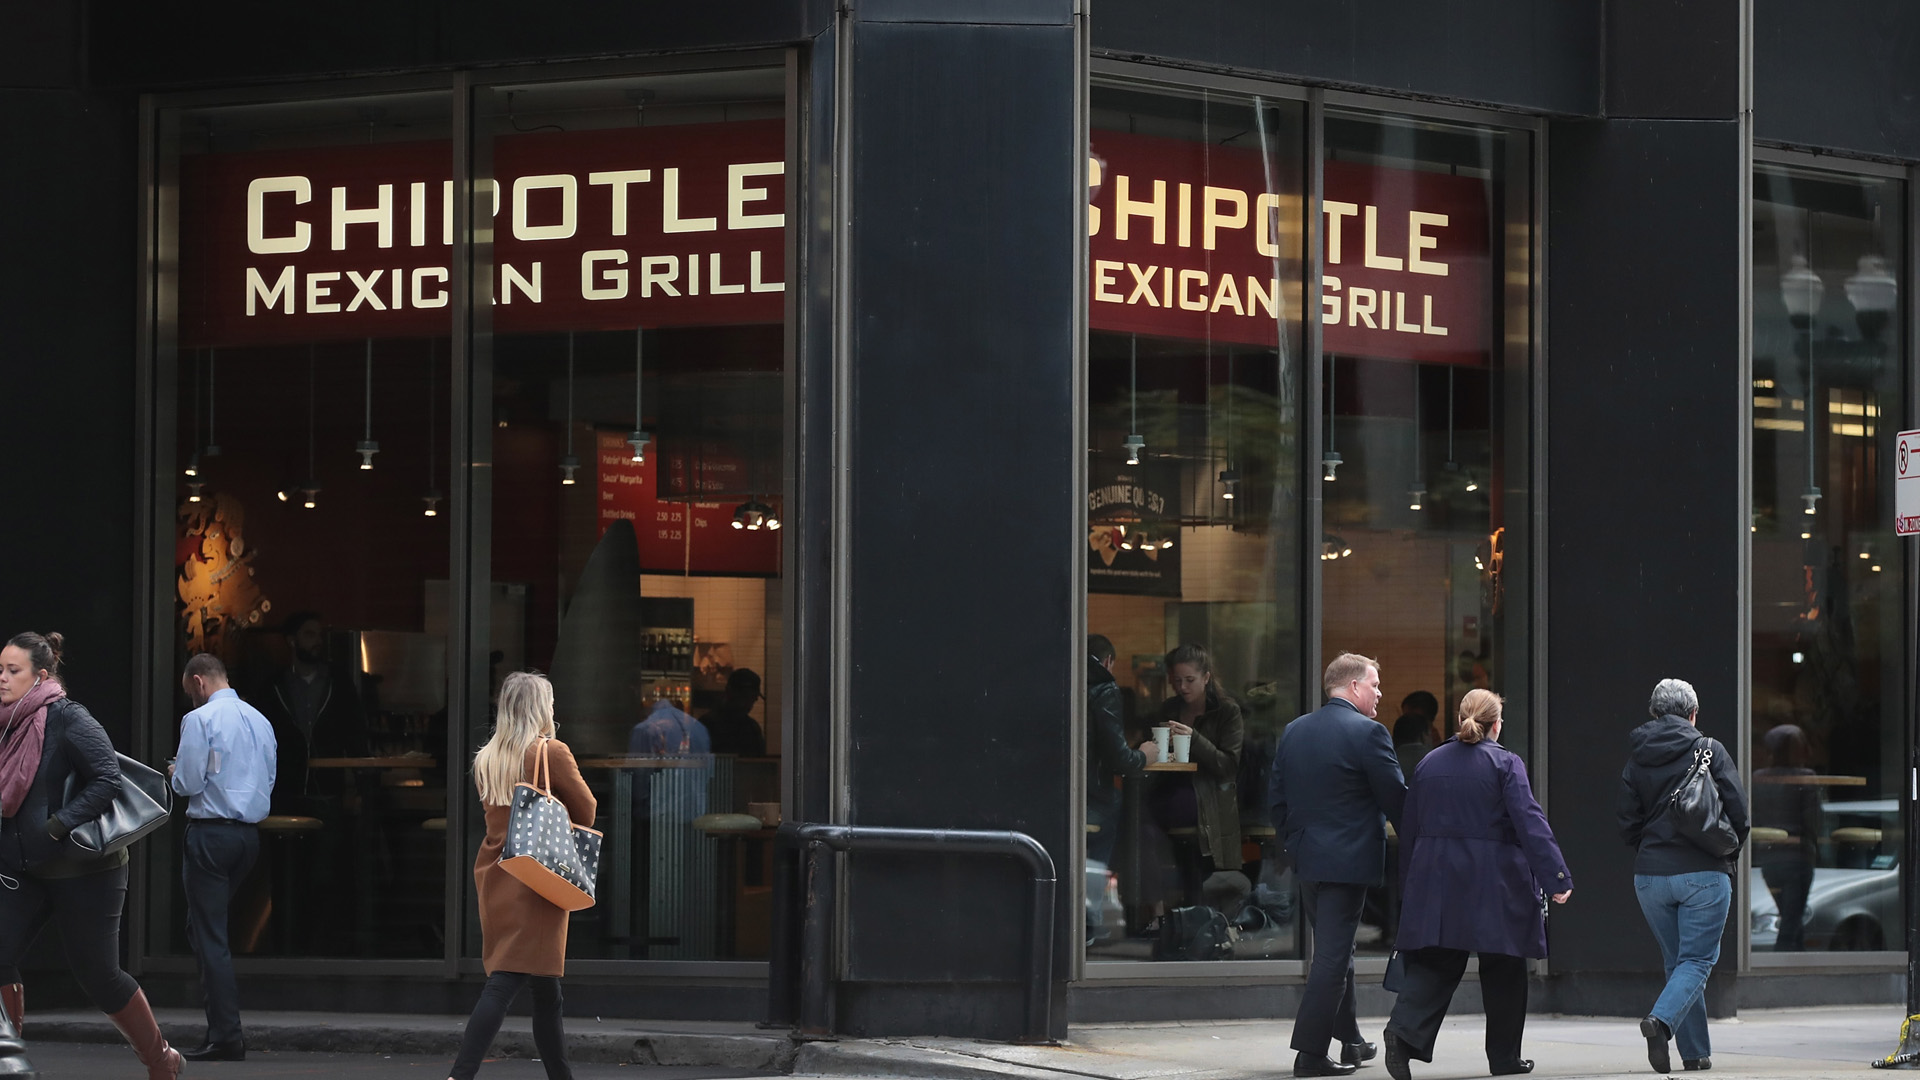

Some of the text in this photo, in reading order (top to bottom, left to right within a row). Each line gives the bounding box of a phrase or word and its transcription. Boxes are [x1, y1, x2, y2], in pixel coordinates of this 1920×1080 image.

[246, 249, 785, 316] MEXICN GRILL
[1088, 485, 1132, 510] GENUINE
[620, 510, 636, 520] Drinks
[656, 511, 669, 522] 2.50
